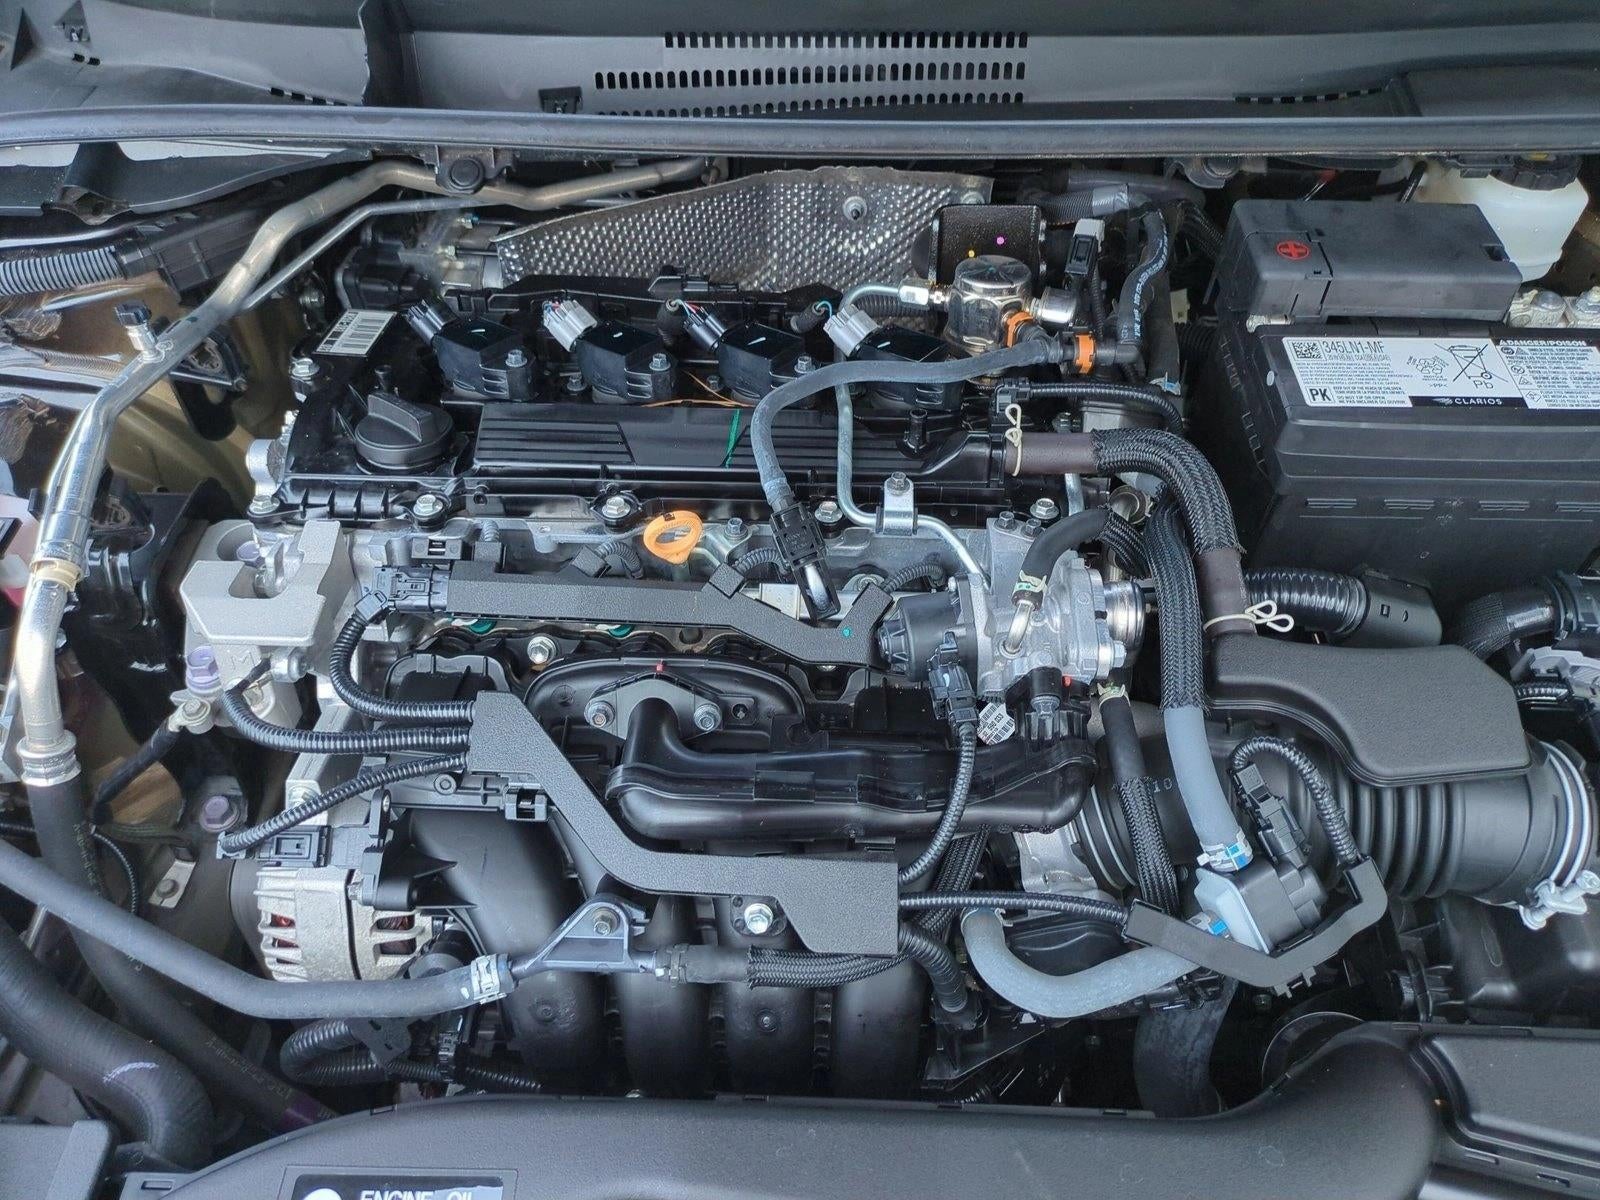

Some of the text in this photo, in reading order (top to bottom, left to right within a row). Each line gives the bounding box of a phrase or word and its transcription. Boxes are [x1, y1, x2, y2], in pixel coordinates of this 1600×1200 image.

[1322, 341, 1385, 354] 345LN1-MF
[1473, 380, 1494, 390] Pb
[1309, 388, 1332, 402] PK
